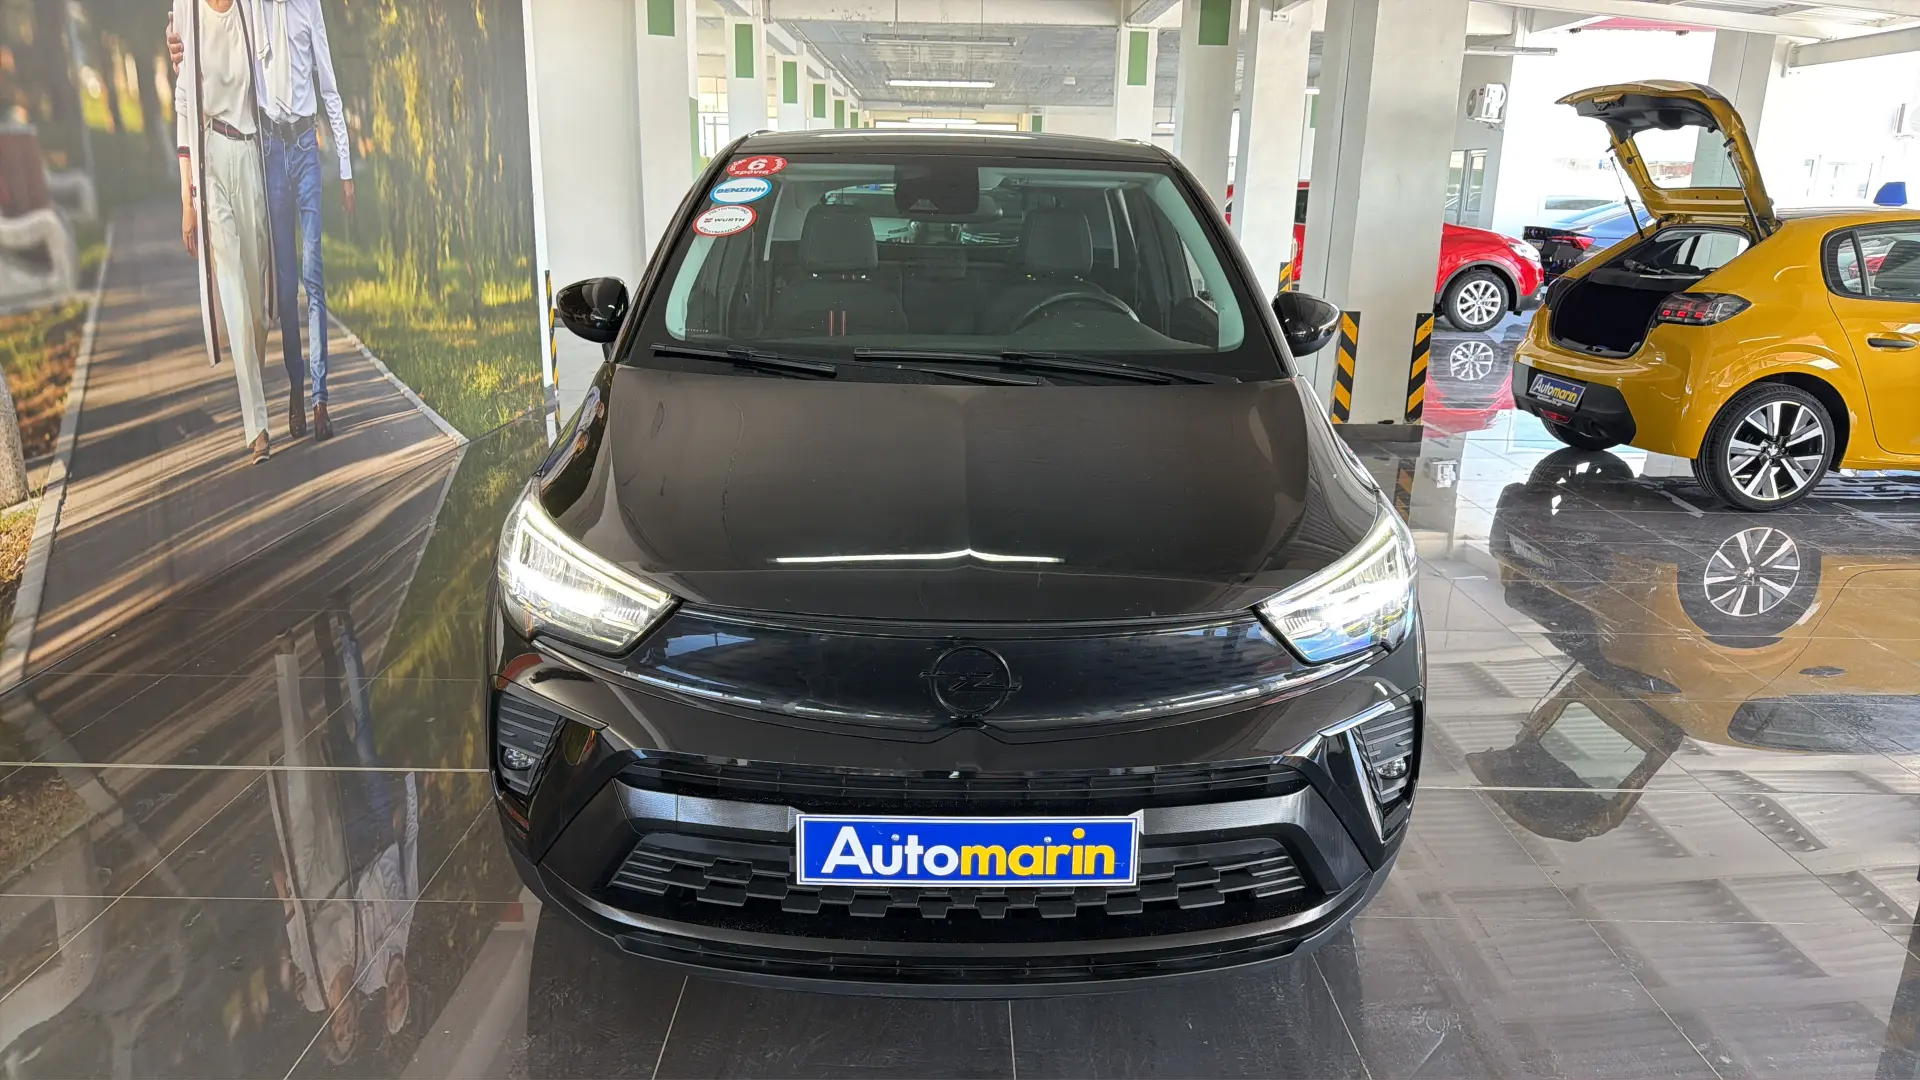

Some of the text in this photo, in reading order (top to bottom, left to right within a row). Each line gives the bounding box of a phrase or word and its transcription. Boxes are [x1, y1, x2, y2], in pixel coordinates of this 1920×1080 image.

[748, 159, 768, 170] 6
[1533, 378, 1577, 402] Automarin
[820, 826, 1116, 876] Automarin
